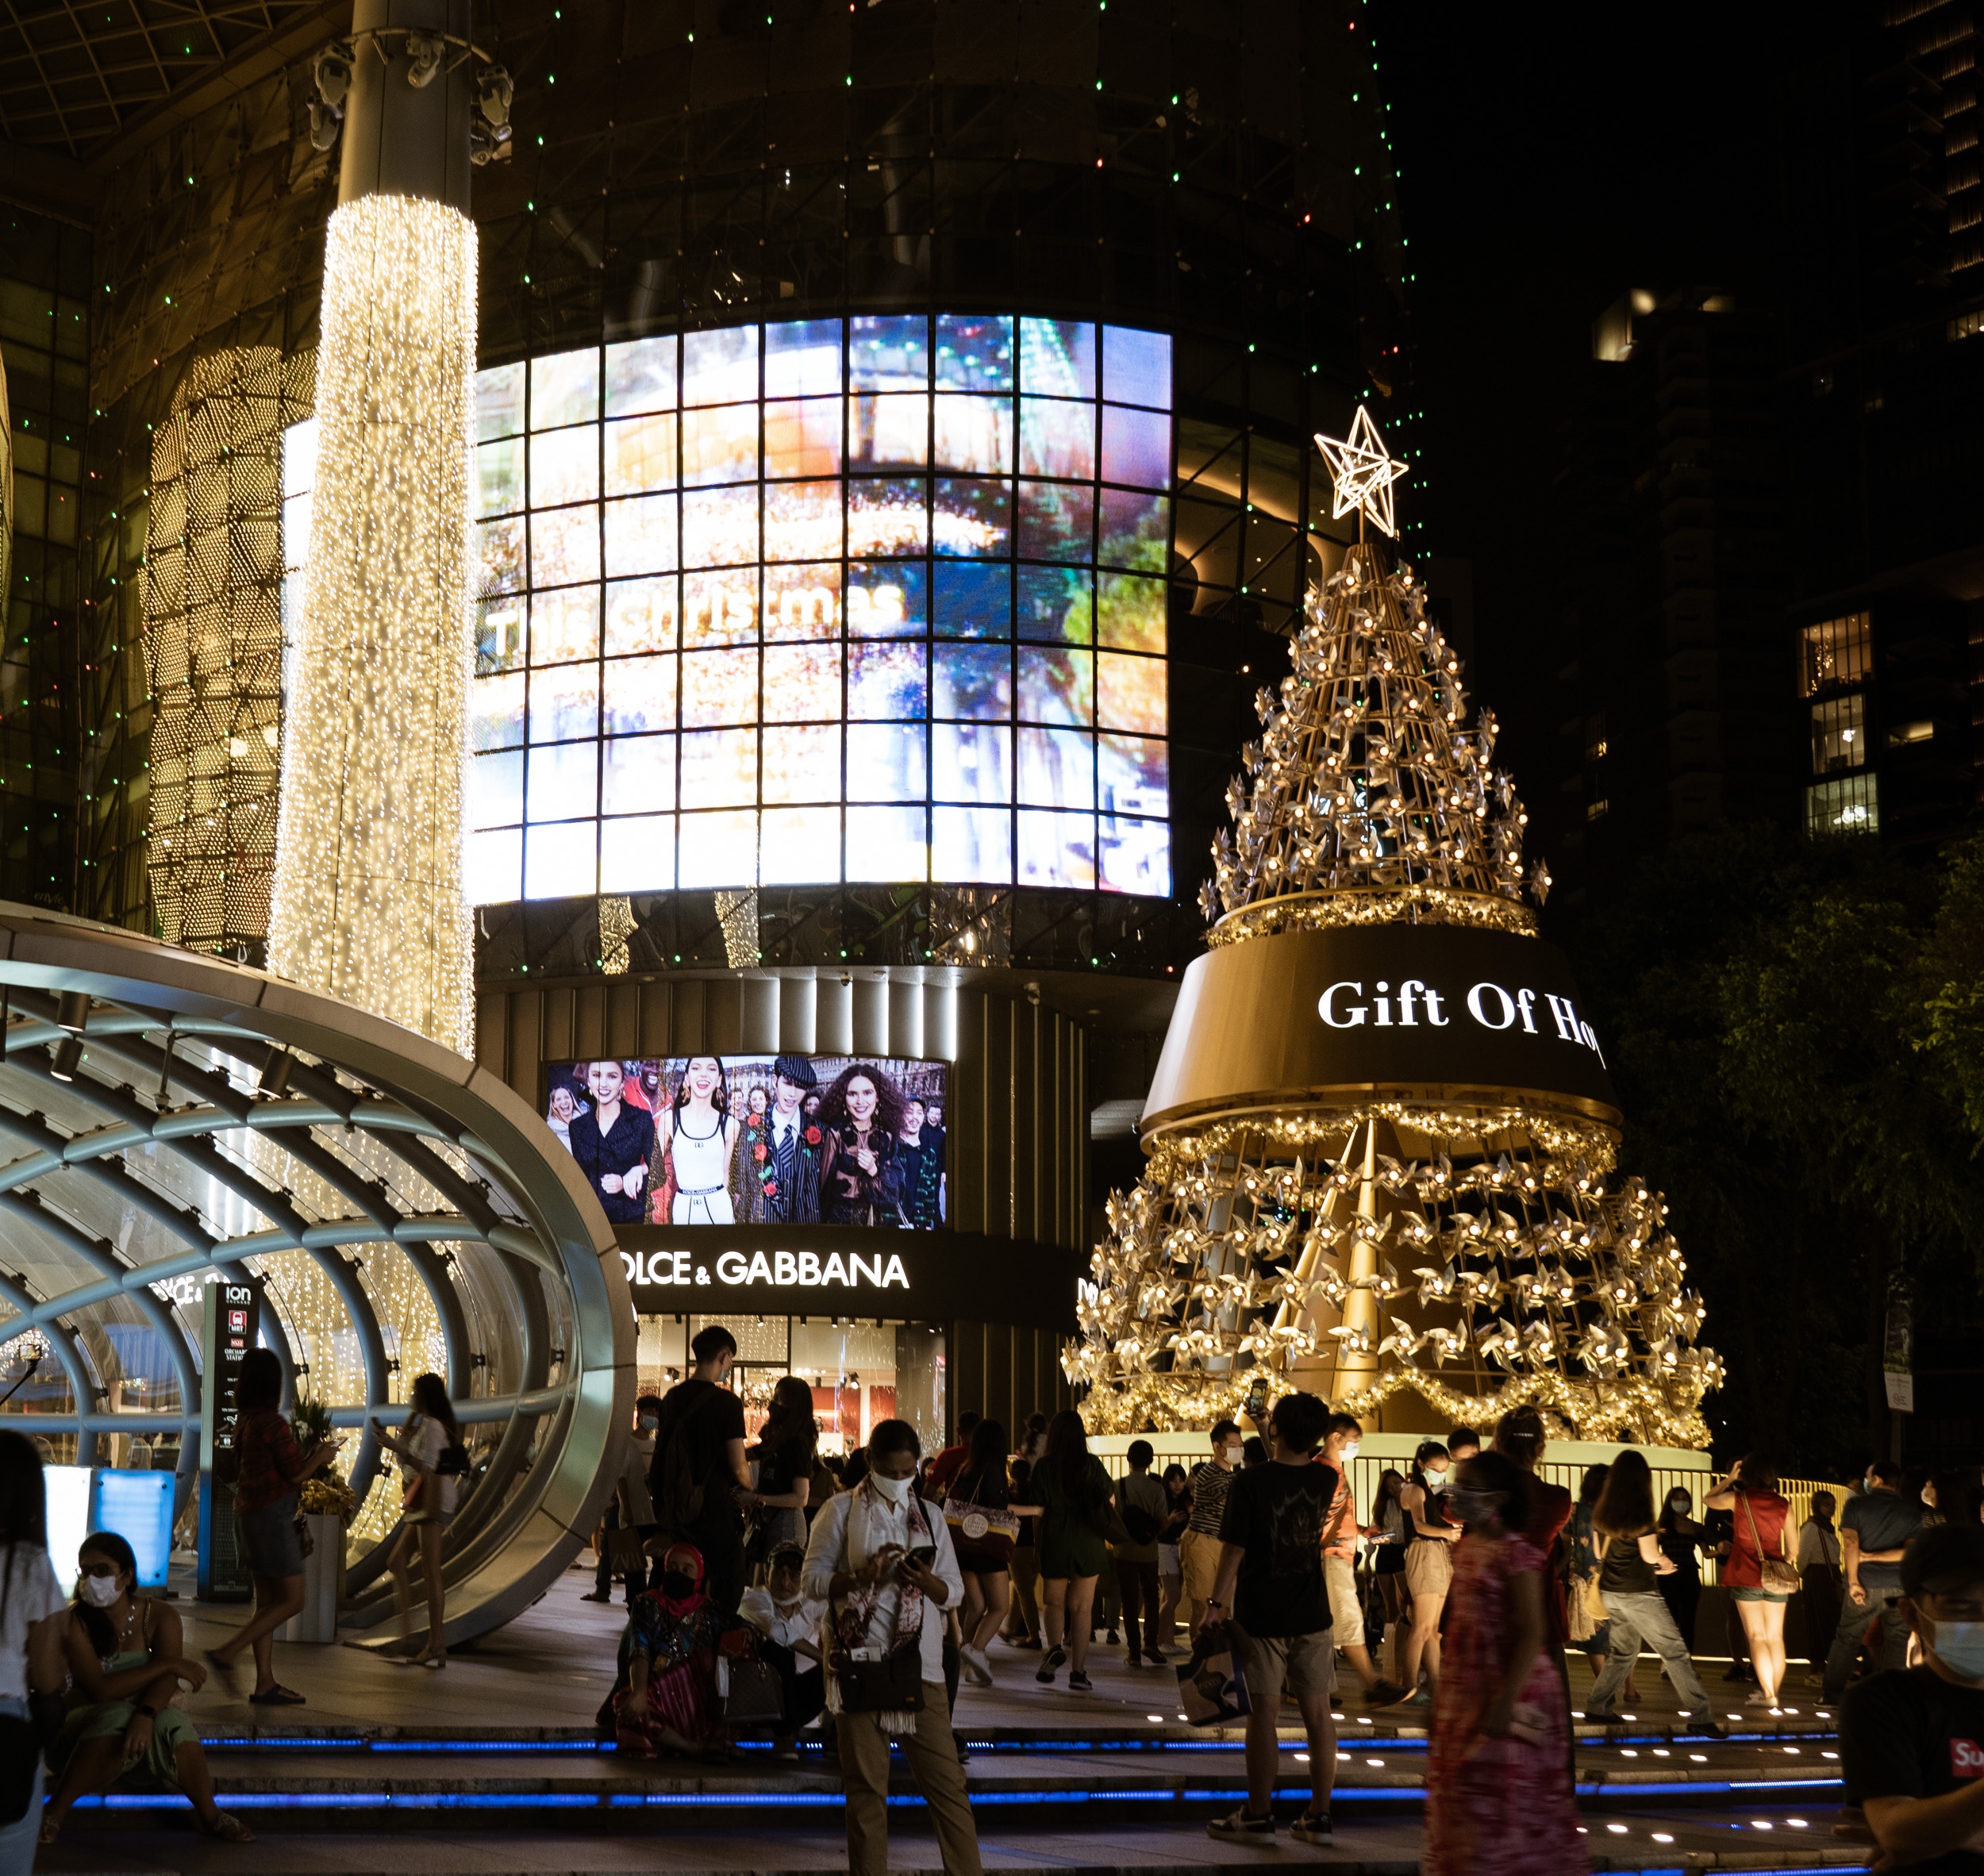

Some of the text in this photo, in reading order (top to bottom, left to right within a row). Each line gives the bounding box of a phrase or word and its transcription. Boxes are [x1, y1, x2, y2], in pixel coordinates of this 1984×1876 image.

[484, 583, 905, 657] This Christmas
[1317, 980, 1449, 1028] Gift
[1467, 982, 1538, 1034] Of
[694, 1266, 712, 1286] &
[716, 1251, 910, 1289] GABBANA
